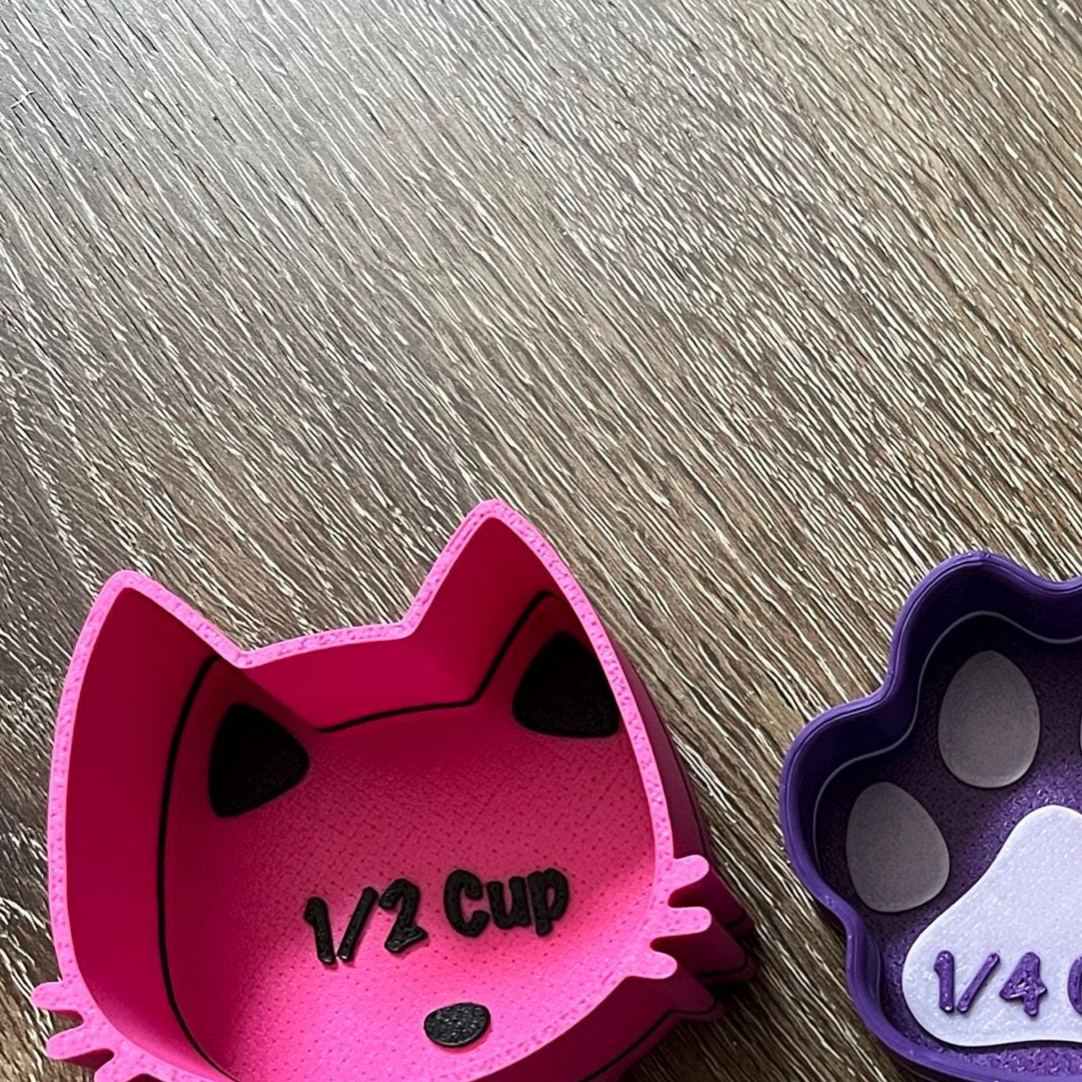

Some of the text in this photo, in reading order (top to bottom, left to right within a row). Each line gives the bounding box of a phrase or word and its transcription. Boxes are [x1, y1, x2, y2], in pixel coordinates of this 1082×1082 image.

[303, 868, 569, 965] 1/2 Cup
[934, 950, 1047, 1017] 1/4
